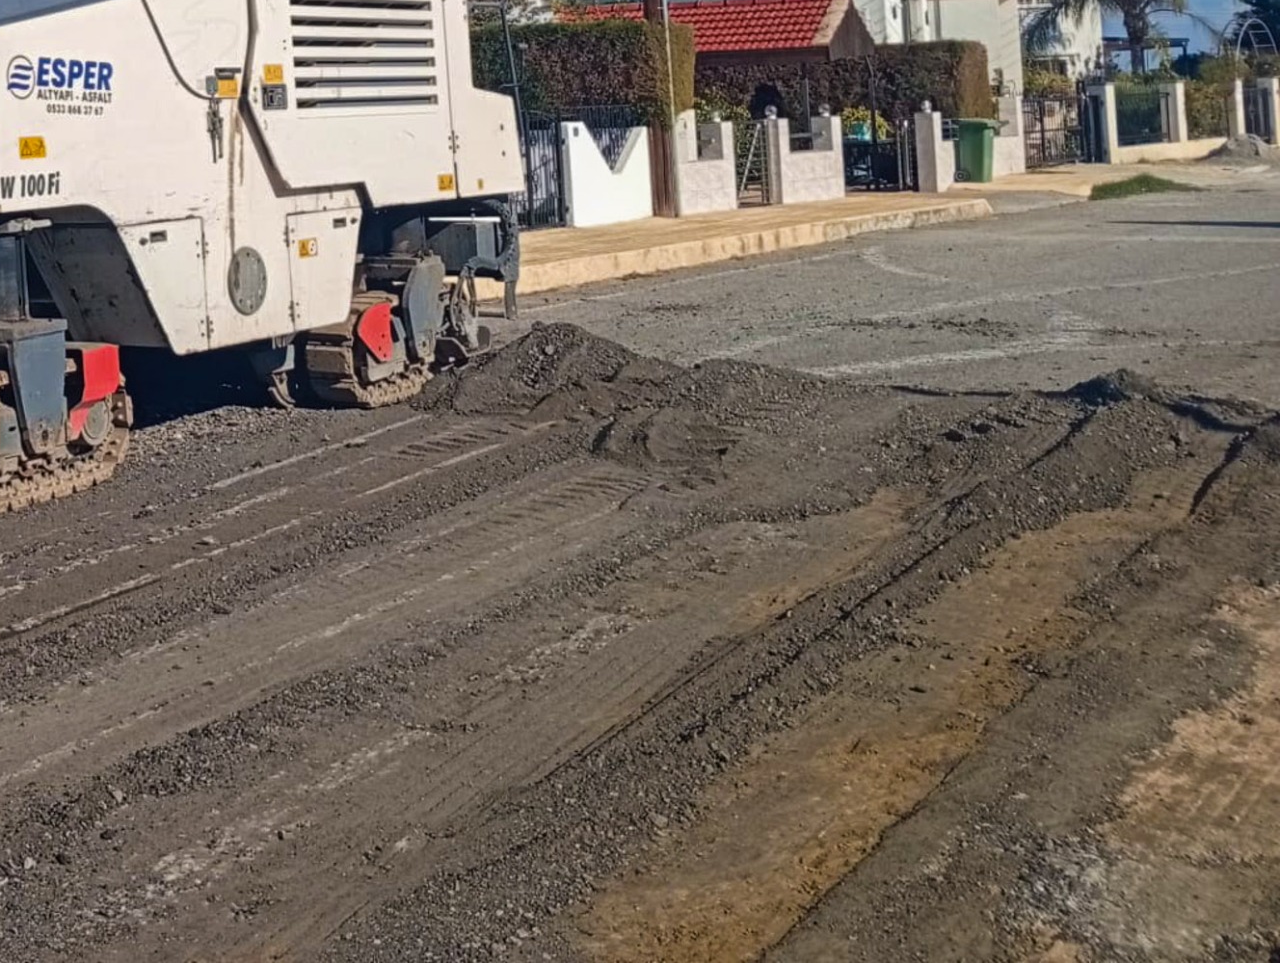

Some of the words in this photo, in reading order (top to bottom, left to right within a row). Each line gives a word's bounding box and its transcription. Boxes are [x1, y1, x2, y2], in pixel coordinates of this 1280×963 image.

[36, 57, 113, 90] ESPER
[36, 89, 73, 101] ALTYAPI
[81, 91, 112, 103] ASFALT
[46, 103, 66, 114] 0533
[0, 176, 15, 199] W
